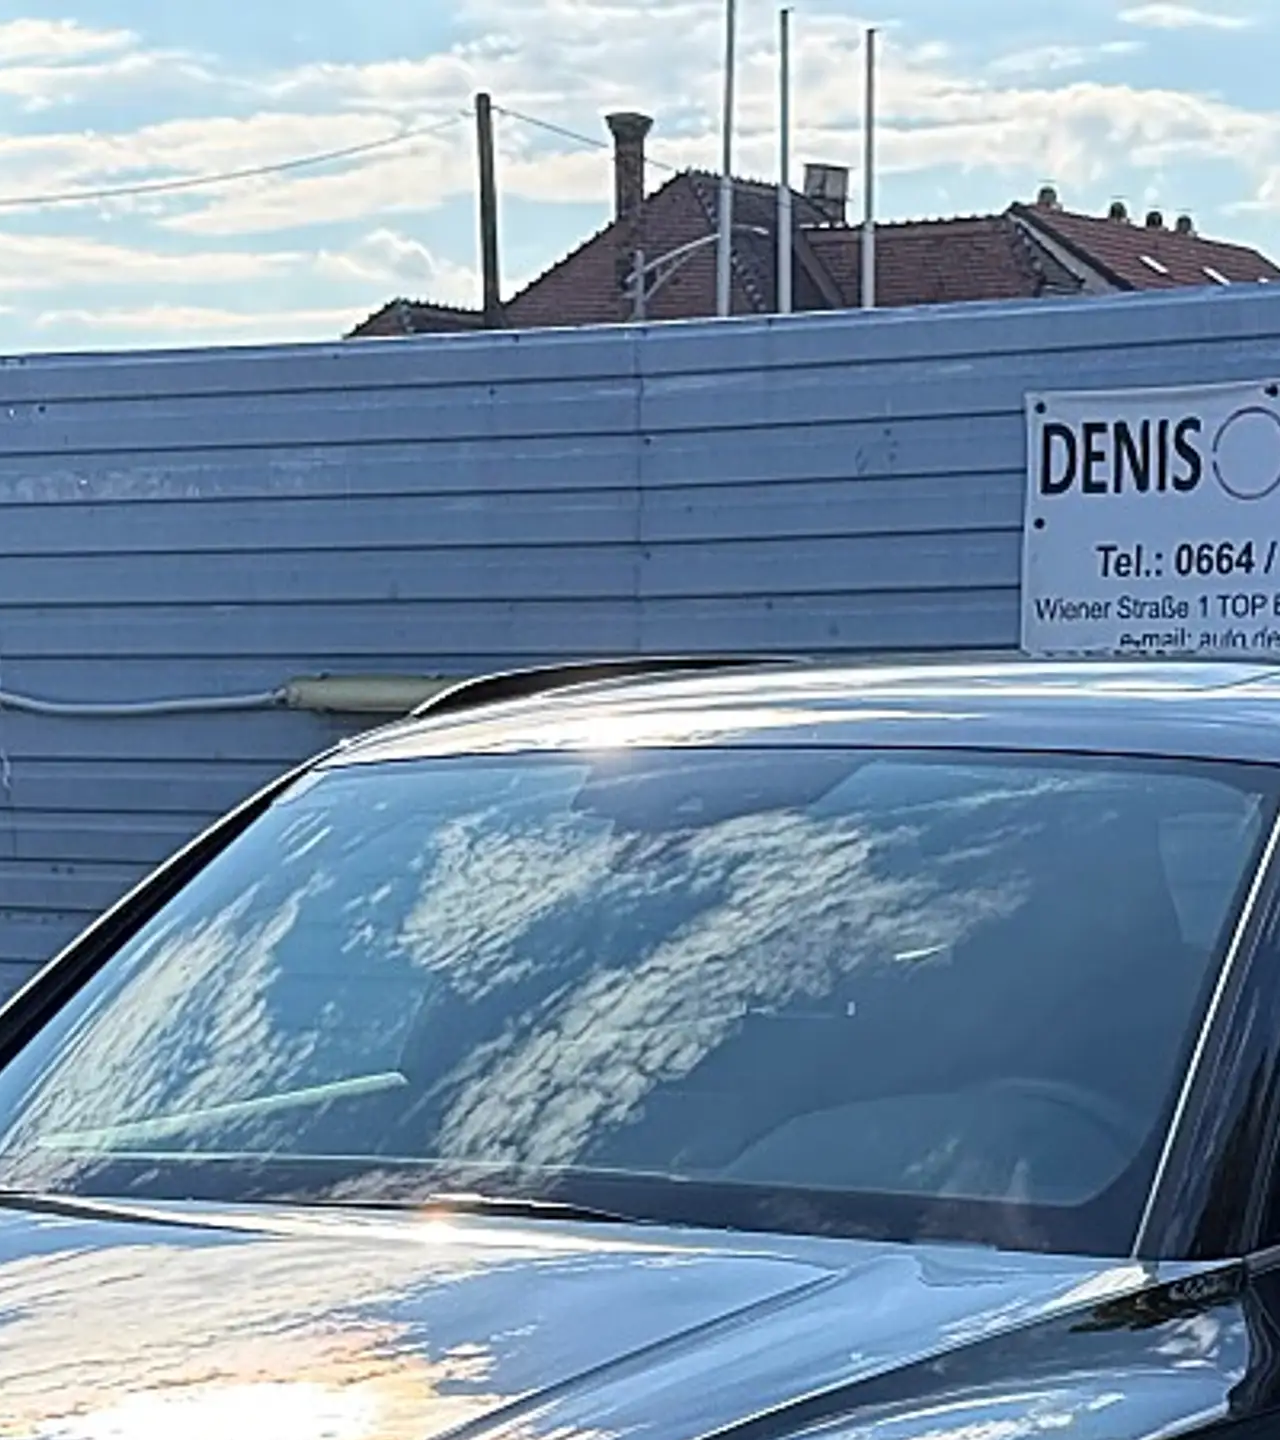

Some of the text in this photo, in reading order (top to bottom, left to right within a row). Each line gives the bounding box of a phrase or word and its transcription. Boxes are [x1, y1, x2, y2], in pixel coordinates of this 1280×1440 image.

[1040, 417, 1204, 497] DENIS
[1097, 545, 1164, 579] Tel.:
[1175, 541, 1255, 577] 0664
[1263, 541, 1277, 576] /
[1035, 597, 1110, 621] Wiener
[1117, 596, 1190, 620] Straße
[1200, 597, 1209, 619] 1
[1219, 595, 1270, 618] TOP
